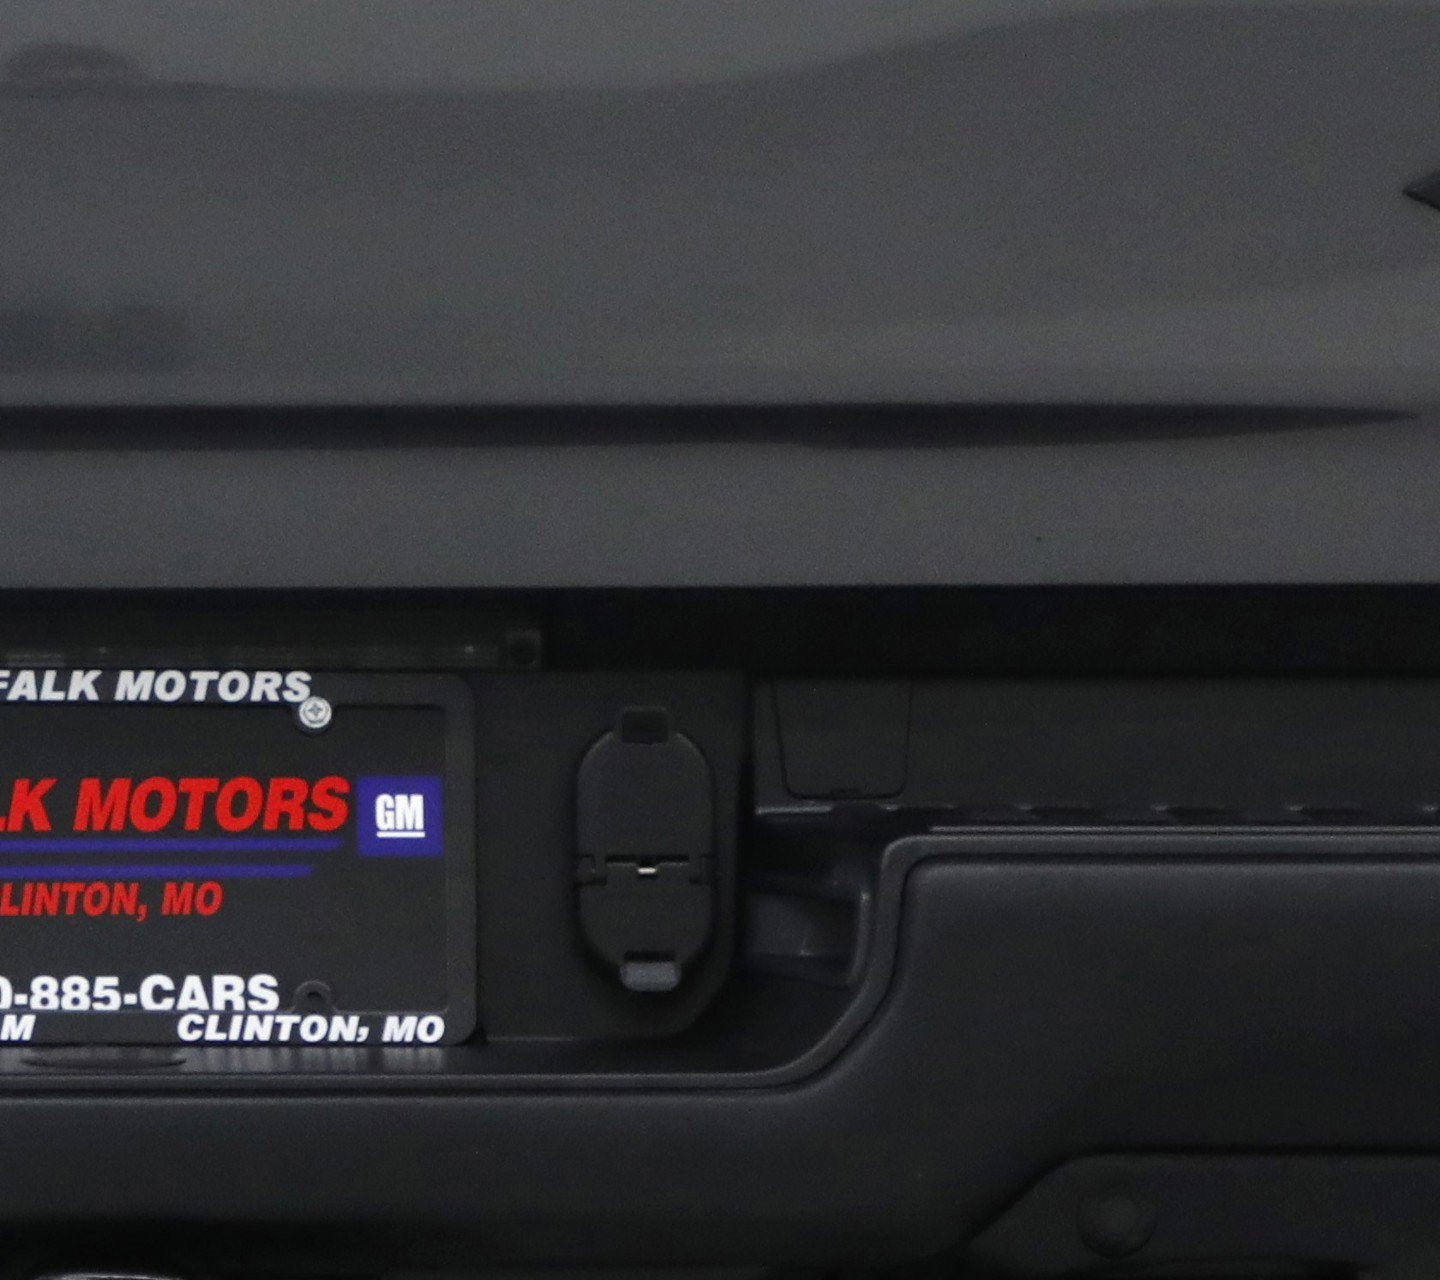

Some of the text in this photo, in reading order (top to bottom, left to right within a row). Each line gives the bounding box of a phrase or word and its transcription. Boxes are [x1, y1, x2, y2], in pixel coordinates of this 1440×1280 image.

[114, 669, 314, 704] MOTORS
[73, 775, 351, 834] MOTORS
[374, 793, 425, 834] GM
[161, 880, 224, 917] MO
[176, 1012, 447, 1045] CLINTON, MO
